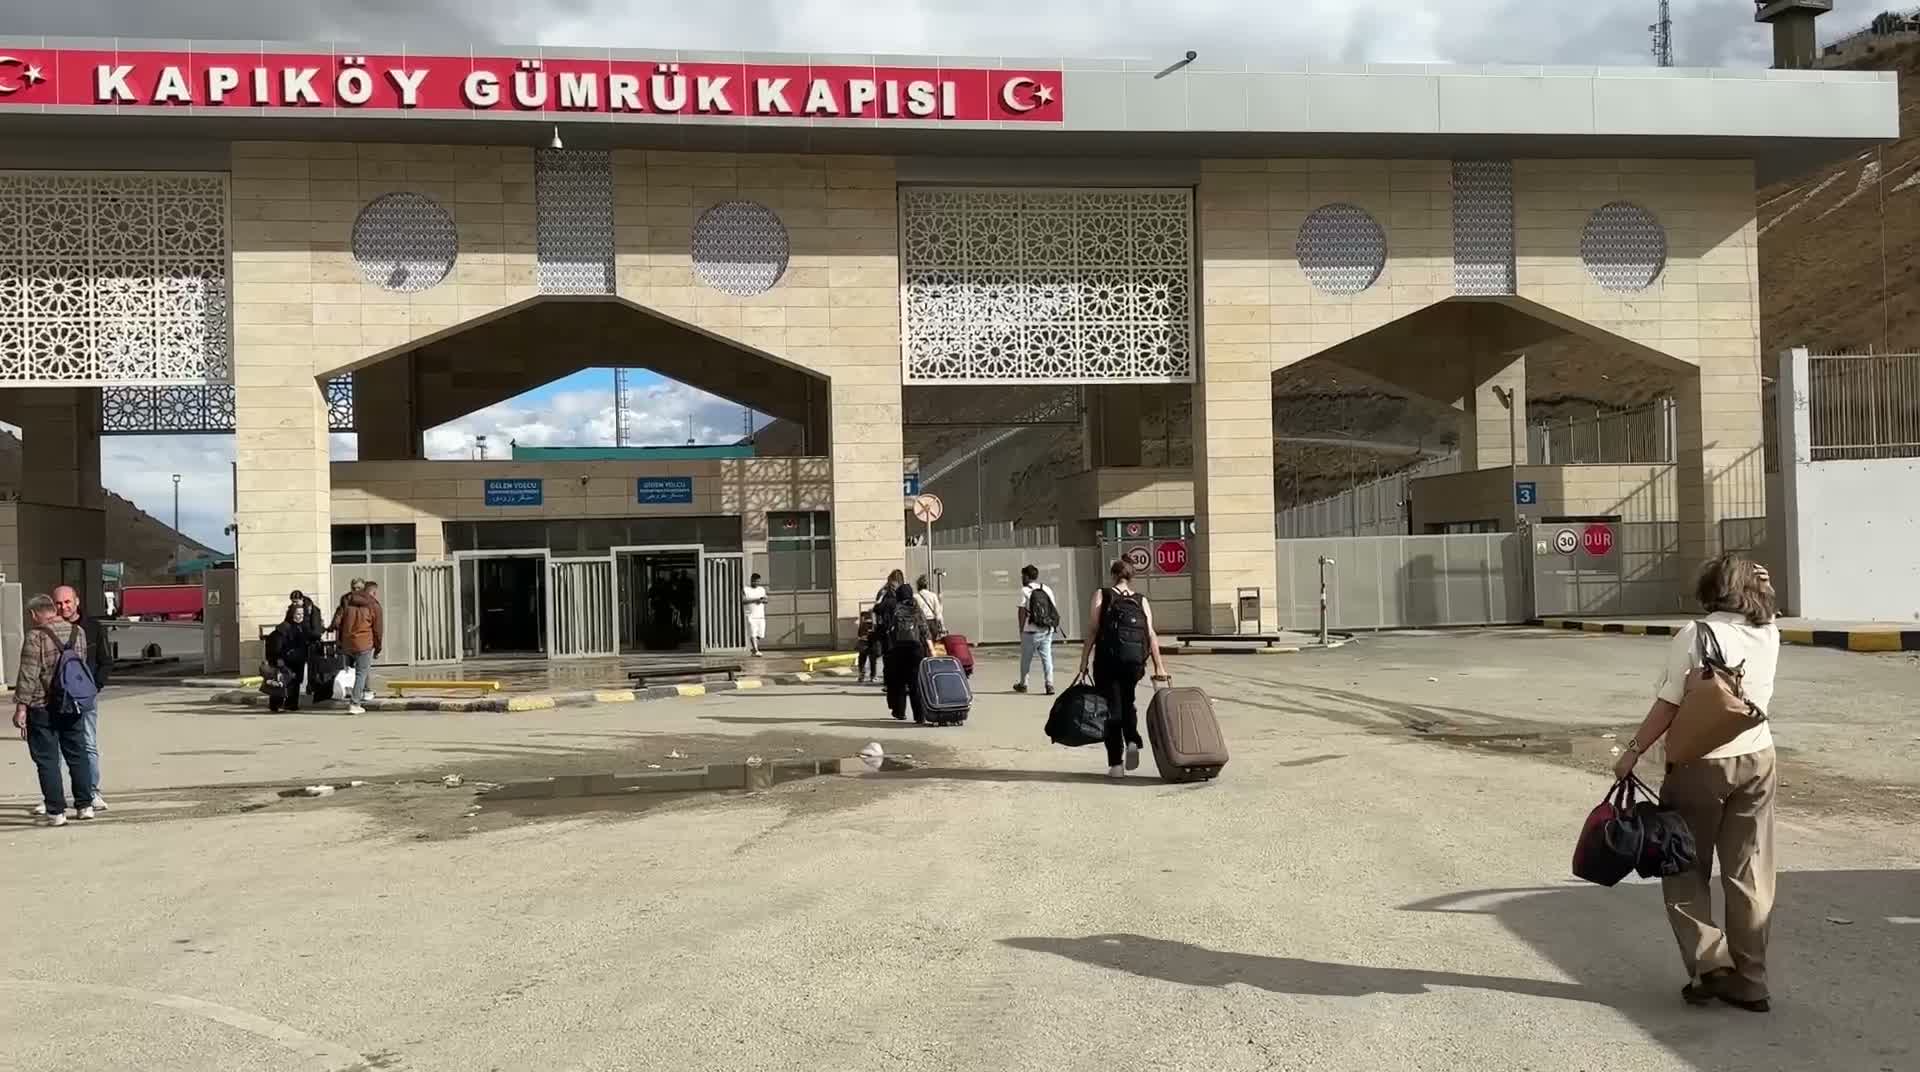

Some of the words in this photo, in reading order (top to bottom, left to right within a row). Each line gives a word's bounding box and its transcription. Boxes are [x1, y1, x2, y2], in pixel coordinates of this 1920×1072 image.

[97, 56, 431, 107] KAPIKÖY
[463, 59, 733, 112] GÜMRÜK
[756, 77, 957, 118] KAPISI
[1520, 490, 1530, 503] 3
[1560, 537, 1574, 547] 30
[1584, 533, 1612, 546] DUR
[1132, 555, 1147, 565] 30
[1157, 550, 1186, 564] DUR
